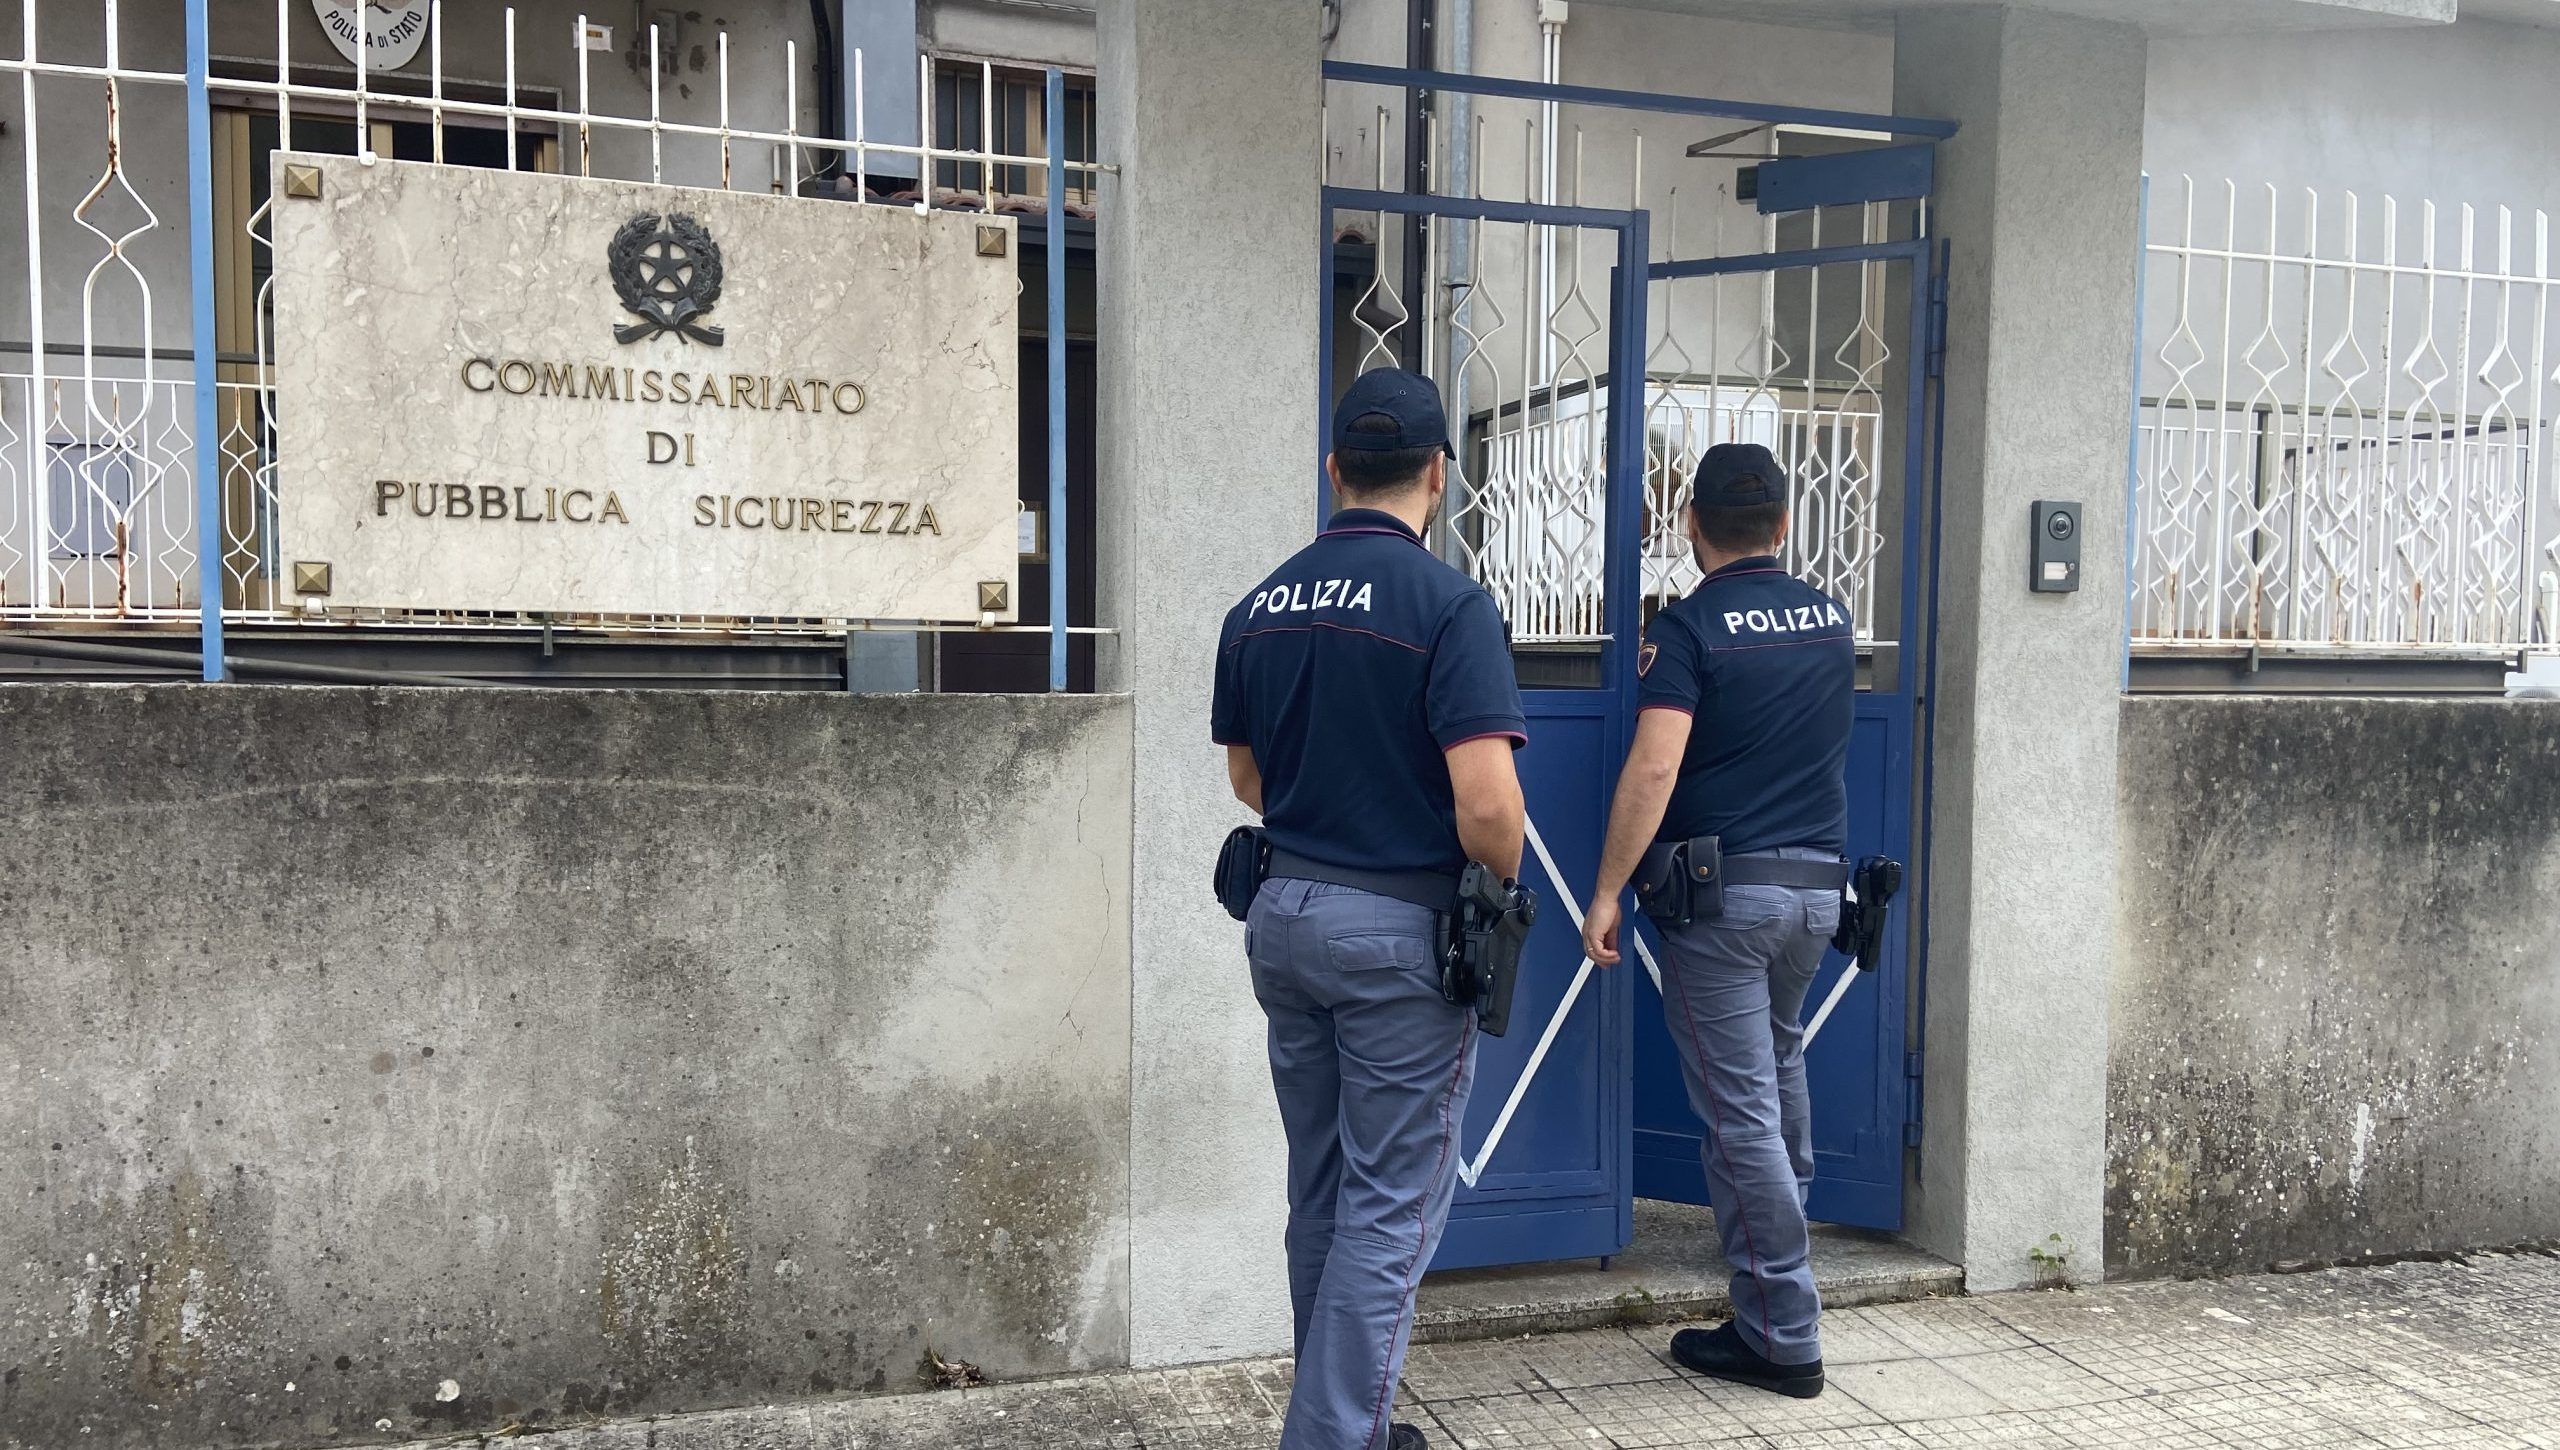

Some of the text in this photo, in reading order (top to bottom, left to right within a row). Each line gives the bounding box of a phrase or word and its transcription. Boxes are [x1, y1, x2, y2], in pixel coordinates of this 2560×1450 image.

[324, 10, 422, 48] POLIZA DI STATO
[462, 357, 866, 414] COMMISSARIATO
[646, 431, 696, 467] DI
[376, 480, 942, 536] PUBBLICA SICUREZZA
[1249, 579, 1373, 619] POLIZIA
[1723, 602, 1844, 634] POLIZIA
